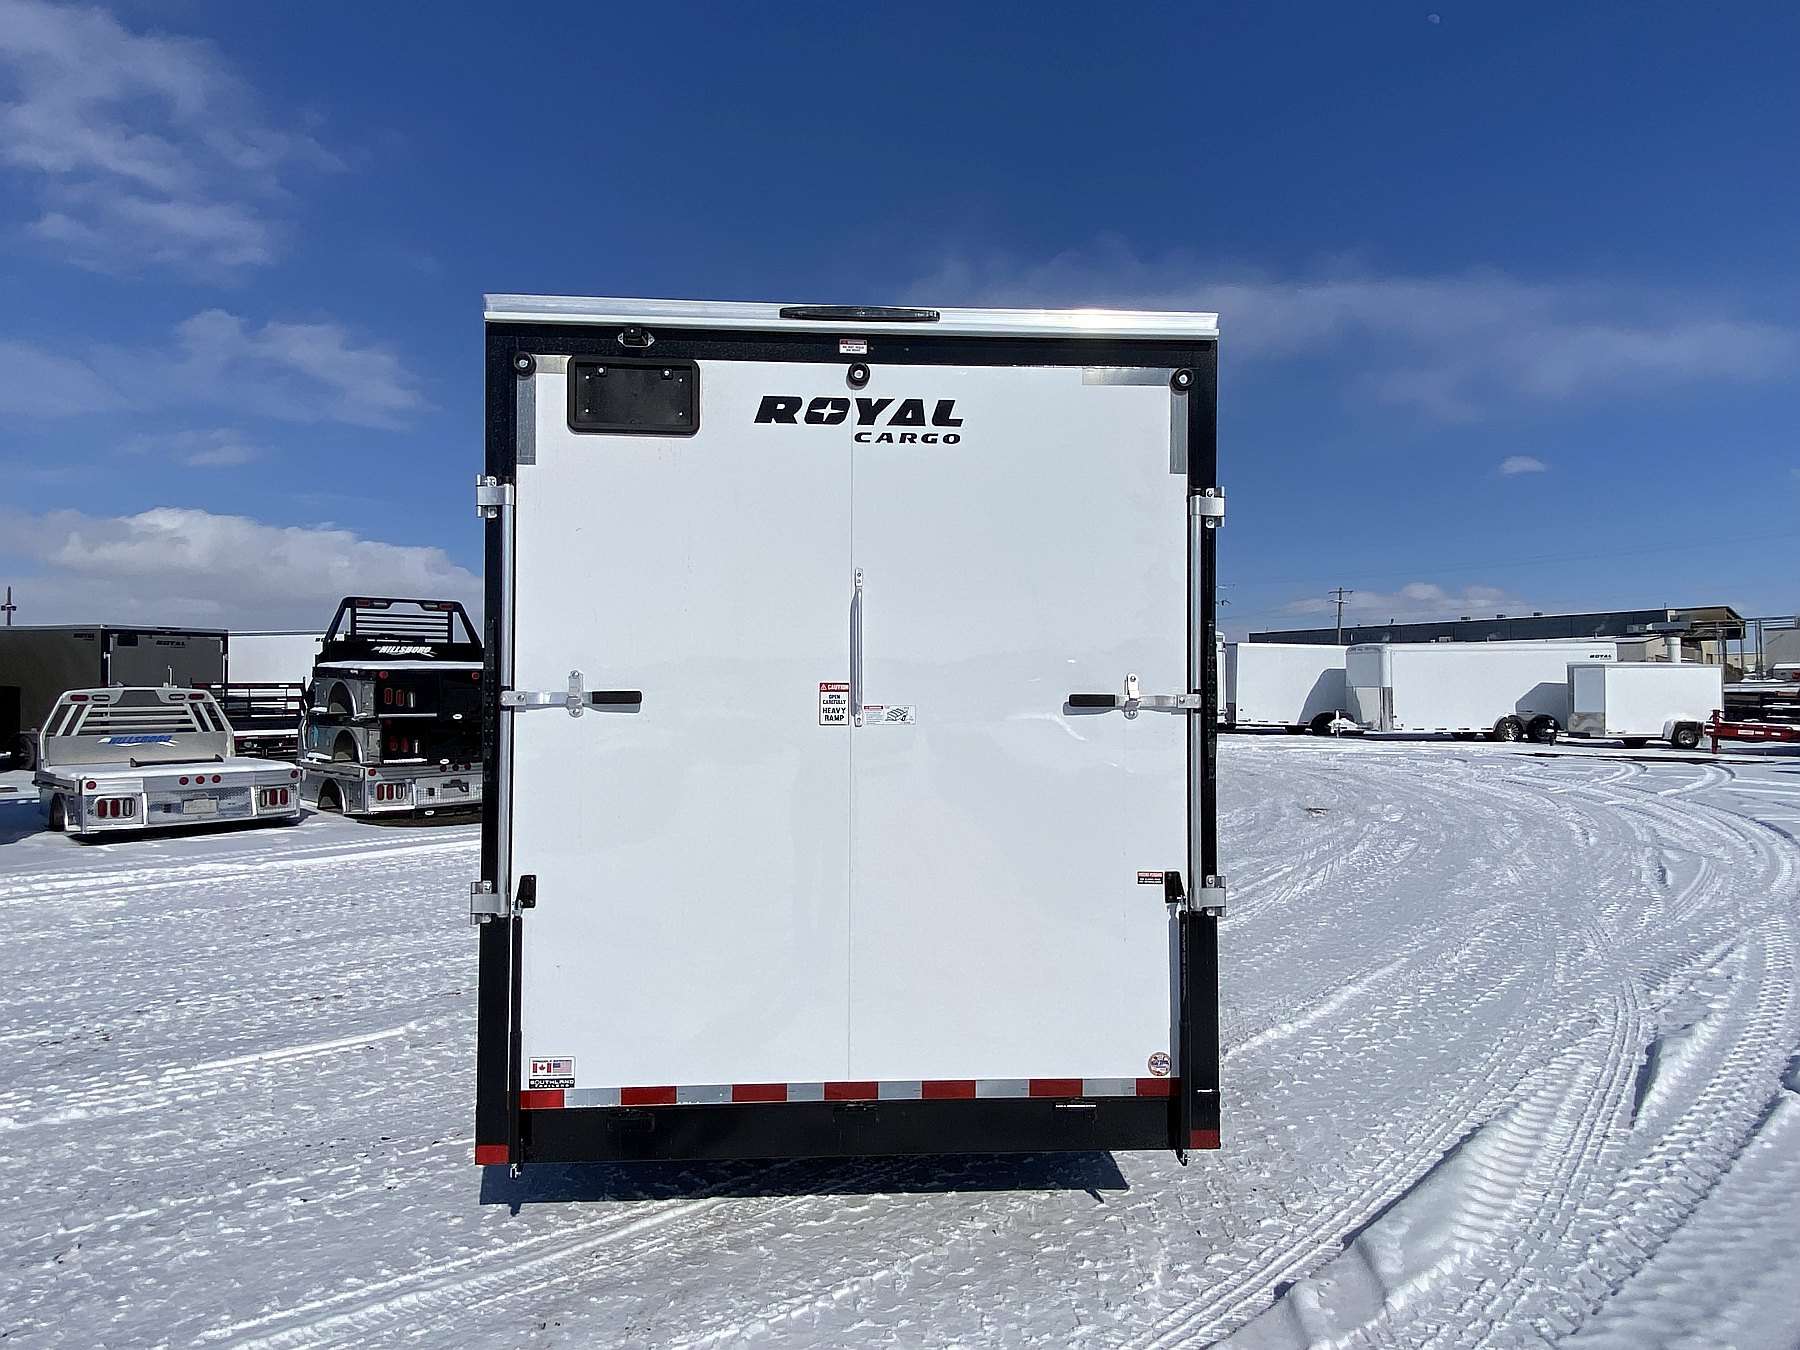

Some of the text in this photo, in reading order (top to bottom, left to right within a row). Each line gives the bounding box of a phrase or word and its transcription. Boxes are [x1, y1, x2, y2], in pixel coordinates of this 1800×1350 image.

[754, 396, 964, 427] ROYAL
[854, 432, 961, 444] CARGO
[378, 646, 432, 654] HILLSBORO
[824, 714, 845, 722] RAMP
